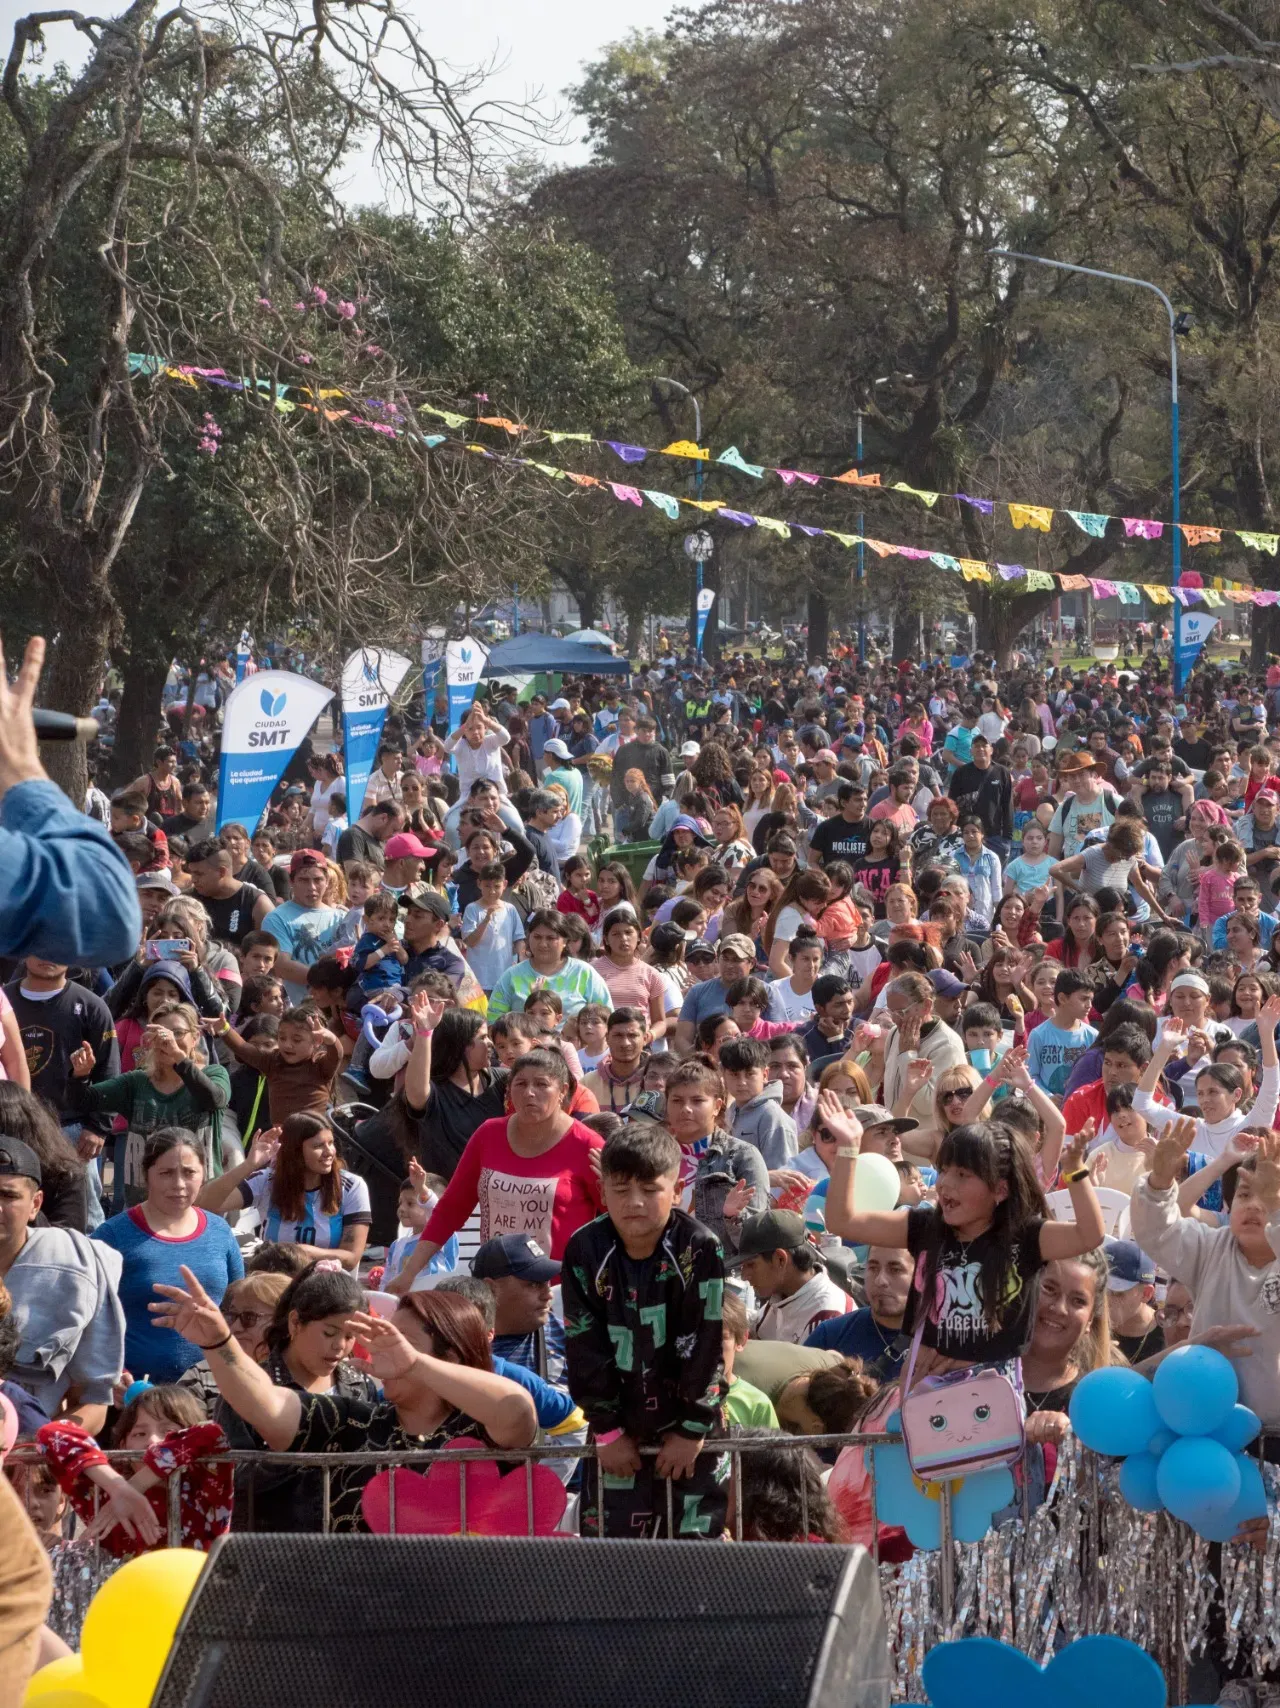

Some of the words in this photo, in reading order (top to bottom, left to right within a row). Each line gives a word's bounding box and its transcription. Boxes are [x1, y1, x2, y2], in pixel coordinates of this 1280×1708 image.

[1185, 634, 1201, 643] SMT
[458, 672, 474, 682] SMT
[359, 693, 385, 707] SMT
[255, 720, 287, 728] CIUDAD
[248, 729, 290, 747] SMT
[239, 769, 263, 777] ciudad
[230, 777, 243, 785] que
[244, 774, 278, 784] queremos
[1152, 815, 1173, 823] CLUB
[1042, 1045, 1062, 1055] STAY
[1042, 1055, 1061, 1064] COOL
[492, 1179, 550, 1195] SUNDAY
[520, 1200, 549, 1213] YOU
[494, 1213, 516, 1229] ARE
[523, 1217, 545, 1230] MY
[294, 1226, 316, 1245] 10
